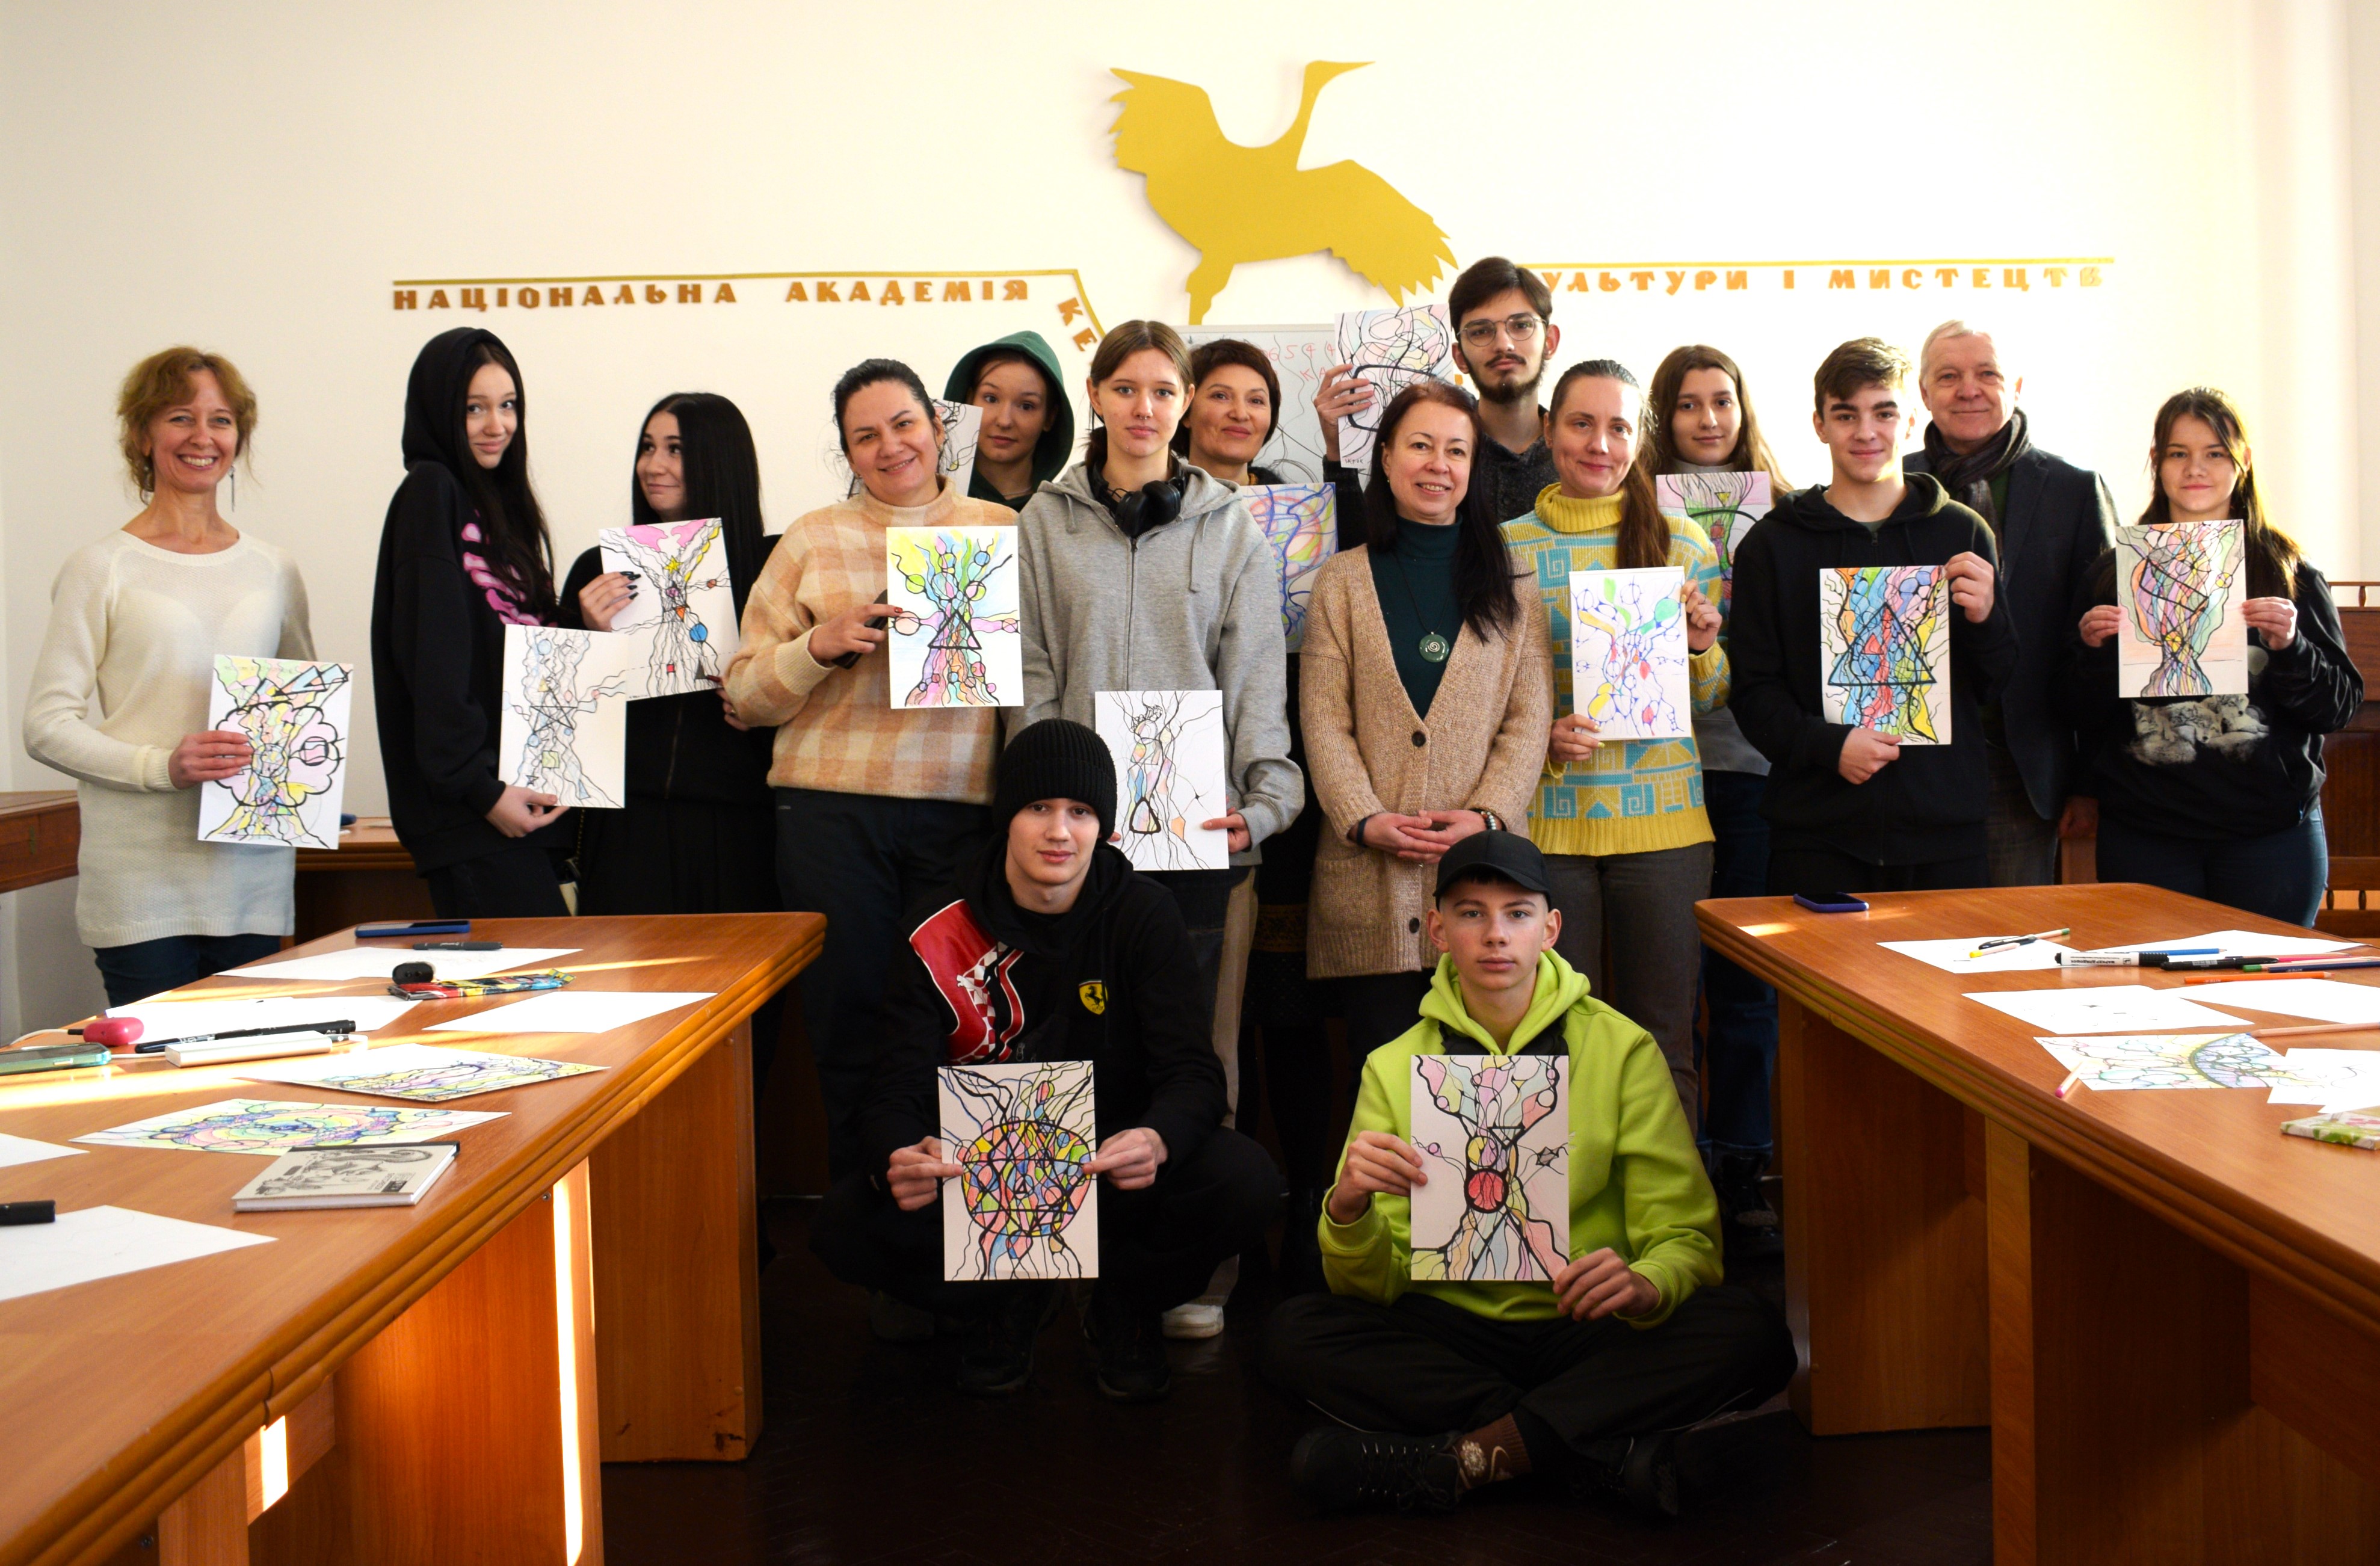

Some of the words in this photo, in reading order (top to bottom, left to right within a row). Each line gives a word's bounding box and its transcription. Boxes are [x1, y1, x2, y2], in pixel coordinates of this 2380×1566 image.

[393, 283, 738, 312] НАЦІОНАЛЬНА
[785, 279, 1028, 306] АКАДЕМІЯ
[1541, 270, 1748, 295] УЛЬТУРИ
[1783, 269, 1795, 290] І
[1828, 267, 2102, 292] МИСТЕЦТВ
